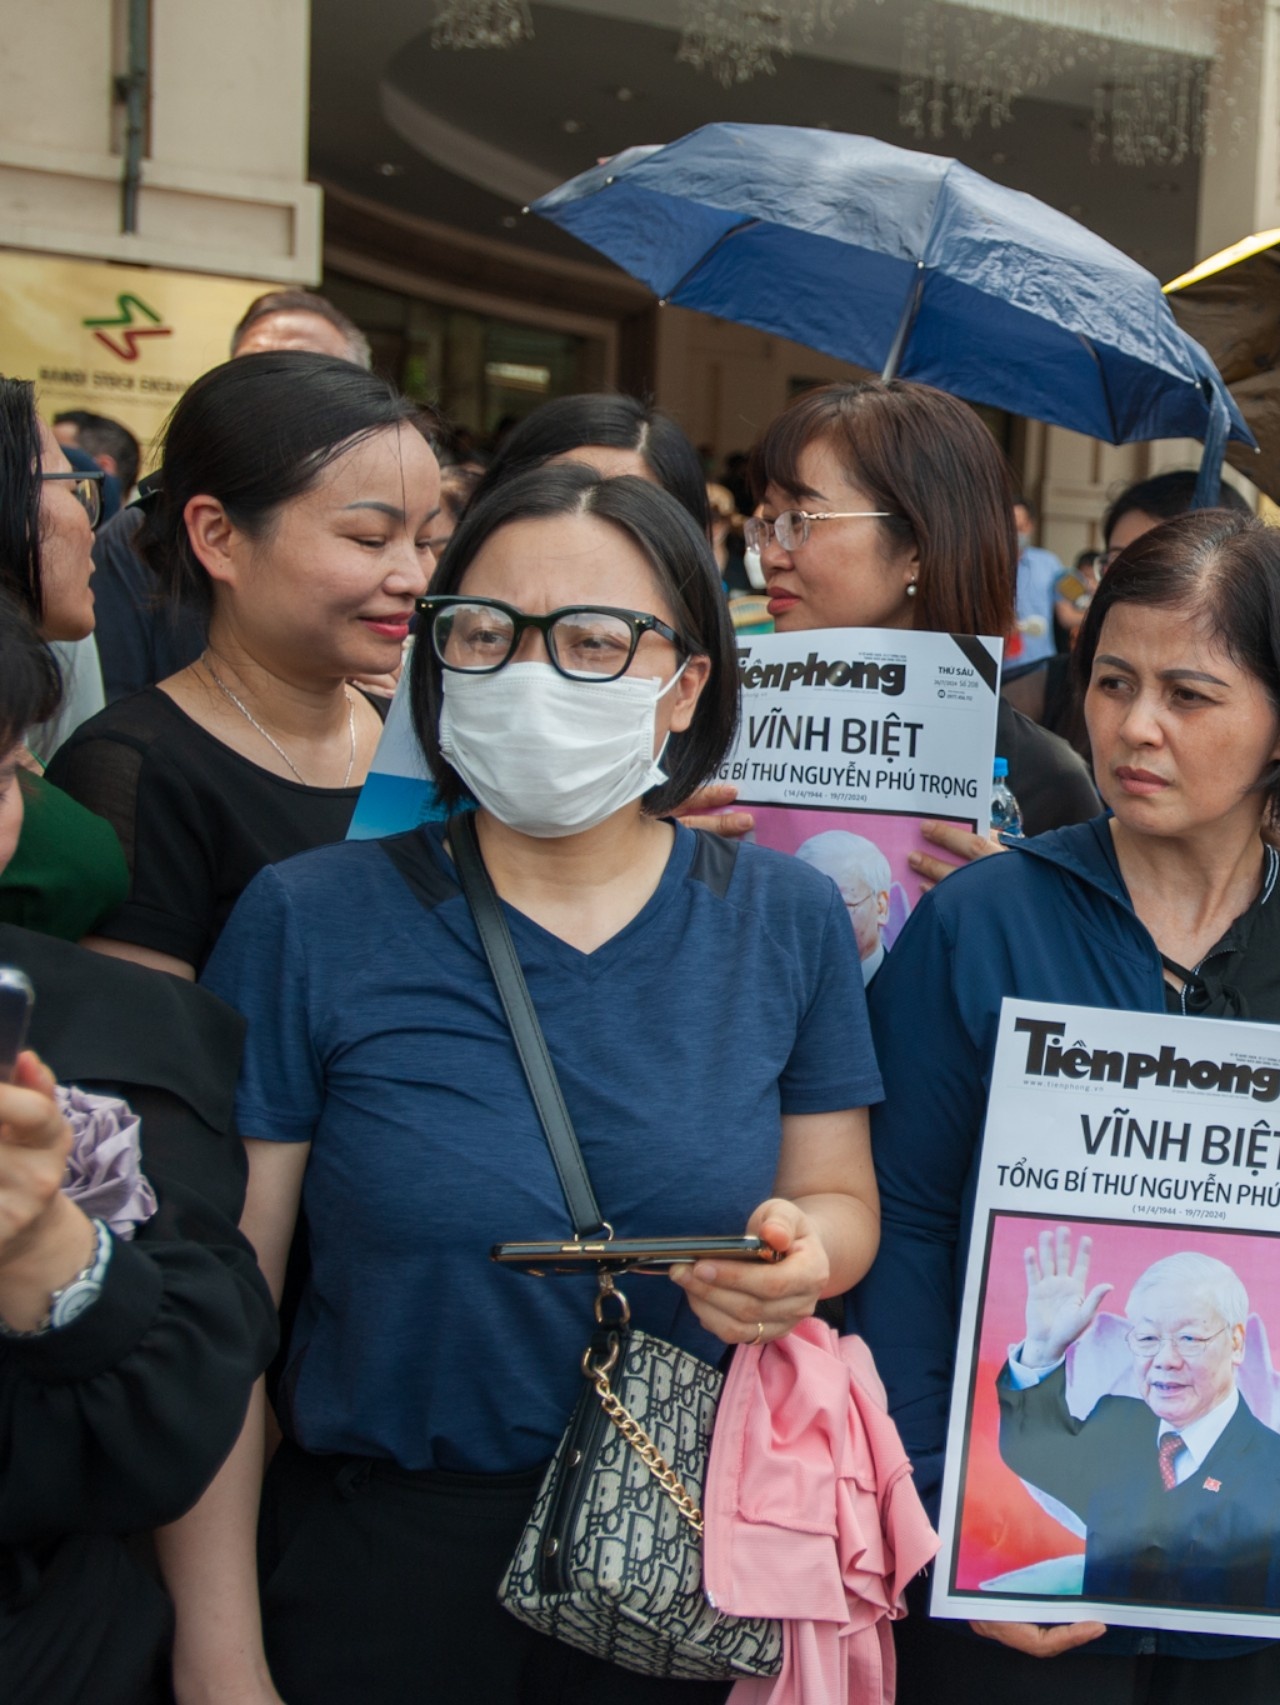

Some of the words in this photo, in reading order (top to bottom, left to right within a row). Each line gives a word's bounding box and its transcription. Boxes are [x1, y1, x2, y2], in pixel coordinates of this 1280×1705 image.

[749, 707, 830, 752] VĨNH
[841, 712, 923, 764] BIỆT
[732, 758, 750, 781] BÍ
[752, 762, 787, 782] THƯ
[790, 761, 871, 788] NGUYỄN
[876, 765, 915, 791] PHÚ
[920, 774, 978, 799] TRỌNG
[1080, 1107, 1191, 1162] VĨNH
[997, 1157, 1058, 1190] TỔNG
[1064, 1166, 1090, 1193] BÍ
[1092, 1172, 1141, 1197] THƯ
[1142, 1173, 1232, 1205] NGUYỄN
